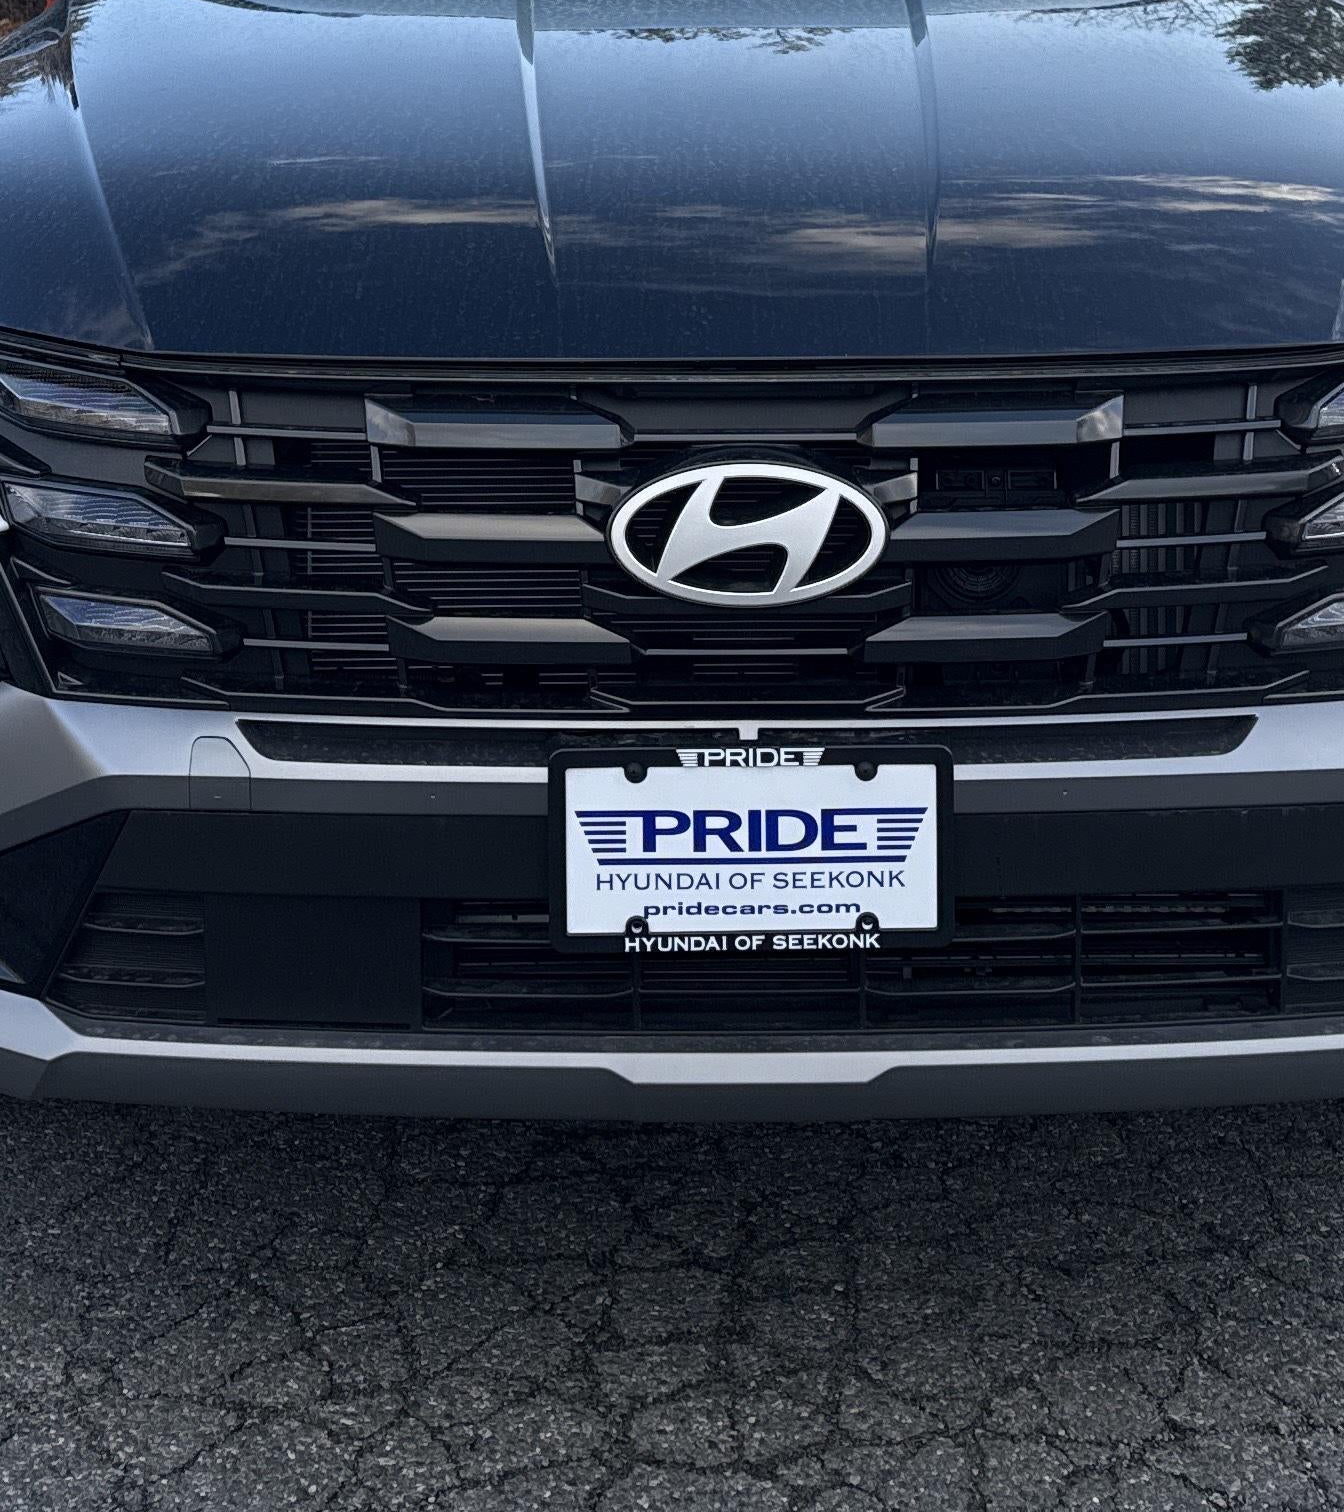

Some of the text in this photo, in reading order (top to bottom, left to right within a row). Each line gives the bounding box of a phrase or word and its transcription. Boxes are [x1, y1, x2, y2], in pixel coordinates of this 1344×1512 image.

[703, 747, 800, 768] PRIDE
[642, 808, 868, 853] PRIDE
[596, 870, 906, 891] HYUNDAI OF SEEKONK
[643, 901, 861, 920] pridecars.com
[624, 933, 881, 953] HYUNDAI OF SEEKONK
